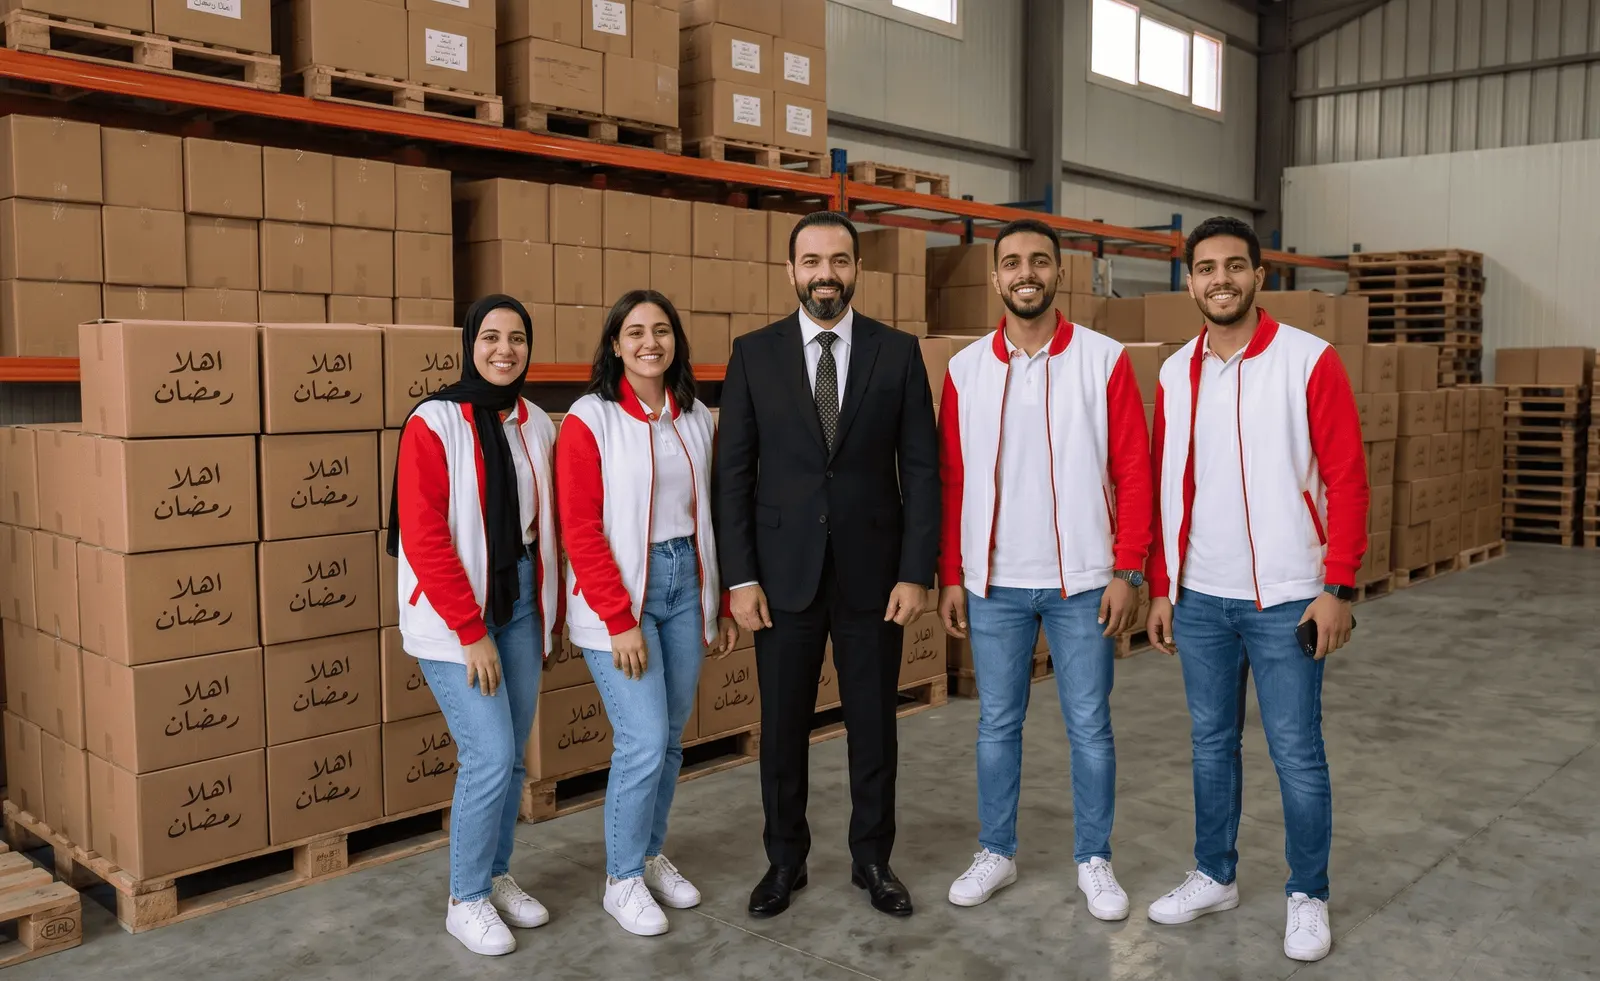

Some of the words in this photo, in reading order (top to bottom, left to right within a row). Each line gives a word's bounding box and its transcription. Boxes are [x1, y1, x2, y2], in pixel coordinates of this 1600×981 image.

[168, 350, 223, 374] اهلا
[306, 352, 353, 375] اهلا
[420, 352, 460, 373] اهلا
[154, 379, 234, 406] رمضان
[293, 379, 363, 405] رمضان
[167, 463, 221, 490] اهلا
[302, 455, 349, 481] اهلا
[154, 495, 232, 521] رمضان
[290, 484, 359, 510] رمضان
[302, 557, 348, 584] اهلا
[169, 572, 222, 600] اهلا
[289, 586, 357, 613] رمضان
[155, 603, 233, 631] رمضان
[912, 628, 934, 645] اهلا
[907, 647, 938, 665] رمضان
[304, 655, 350, 684] اهلا
[721, 666, 750, 689] اهلا
[178, 675, 230, 706] اهلا
[293, 685, 359, 712] رمضان
[714, 692, 755, 711] رمضان
[164, 707, 240, 737] رمضان
[568, 700, 602, 726] اهلا
[416, 731, 452, 756] هلا
[557, 729, 607, 750] رمضان
[307, 749, 353, 781] اهلا
[180, 774, 233, 808] اهلا
[295, 781, 361, 810] رمضان
[167, 807, 242, 839] رمضان
